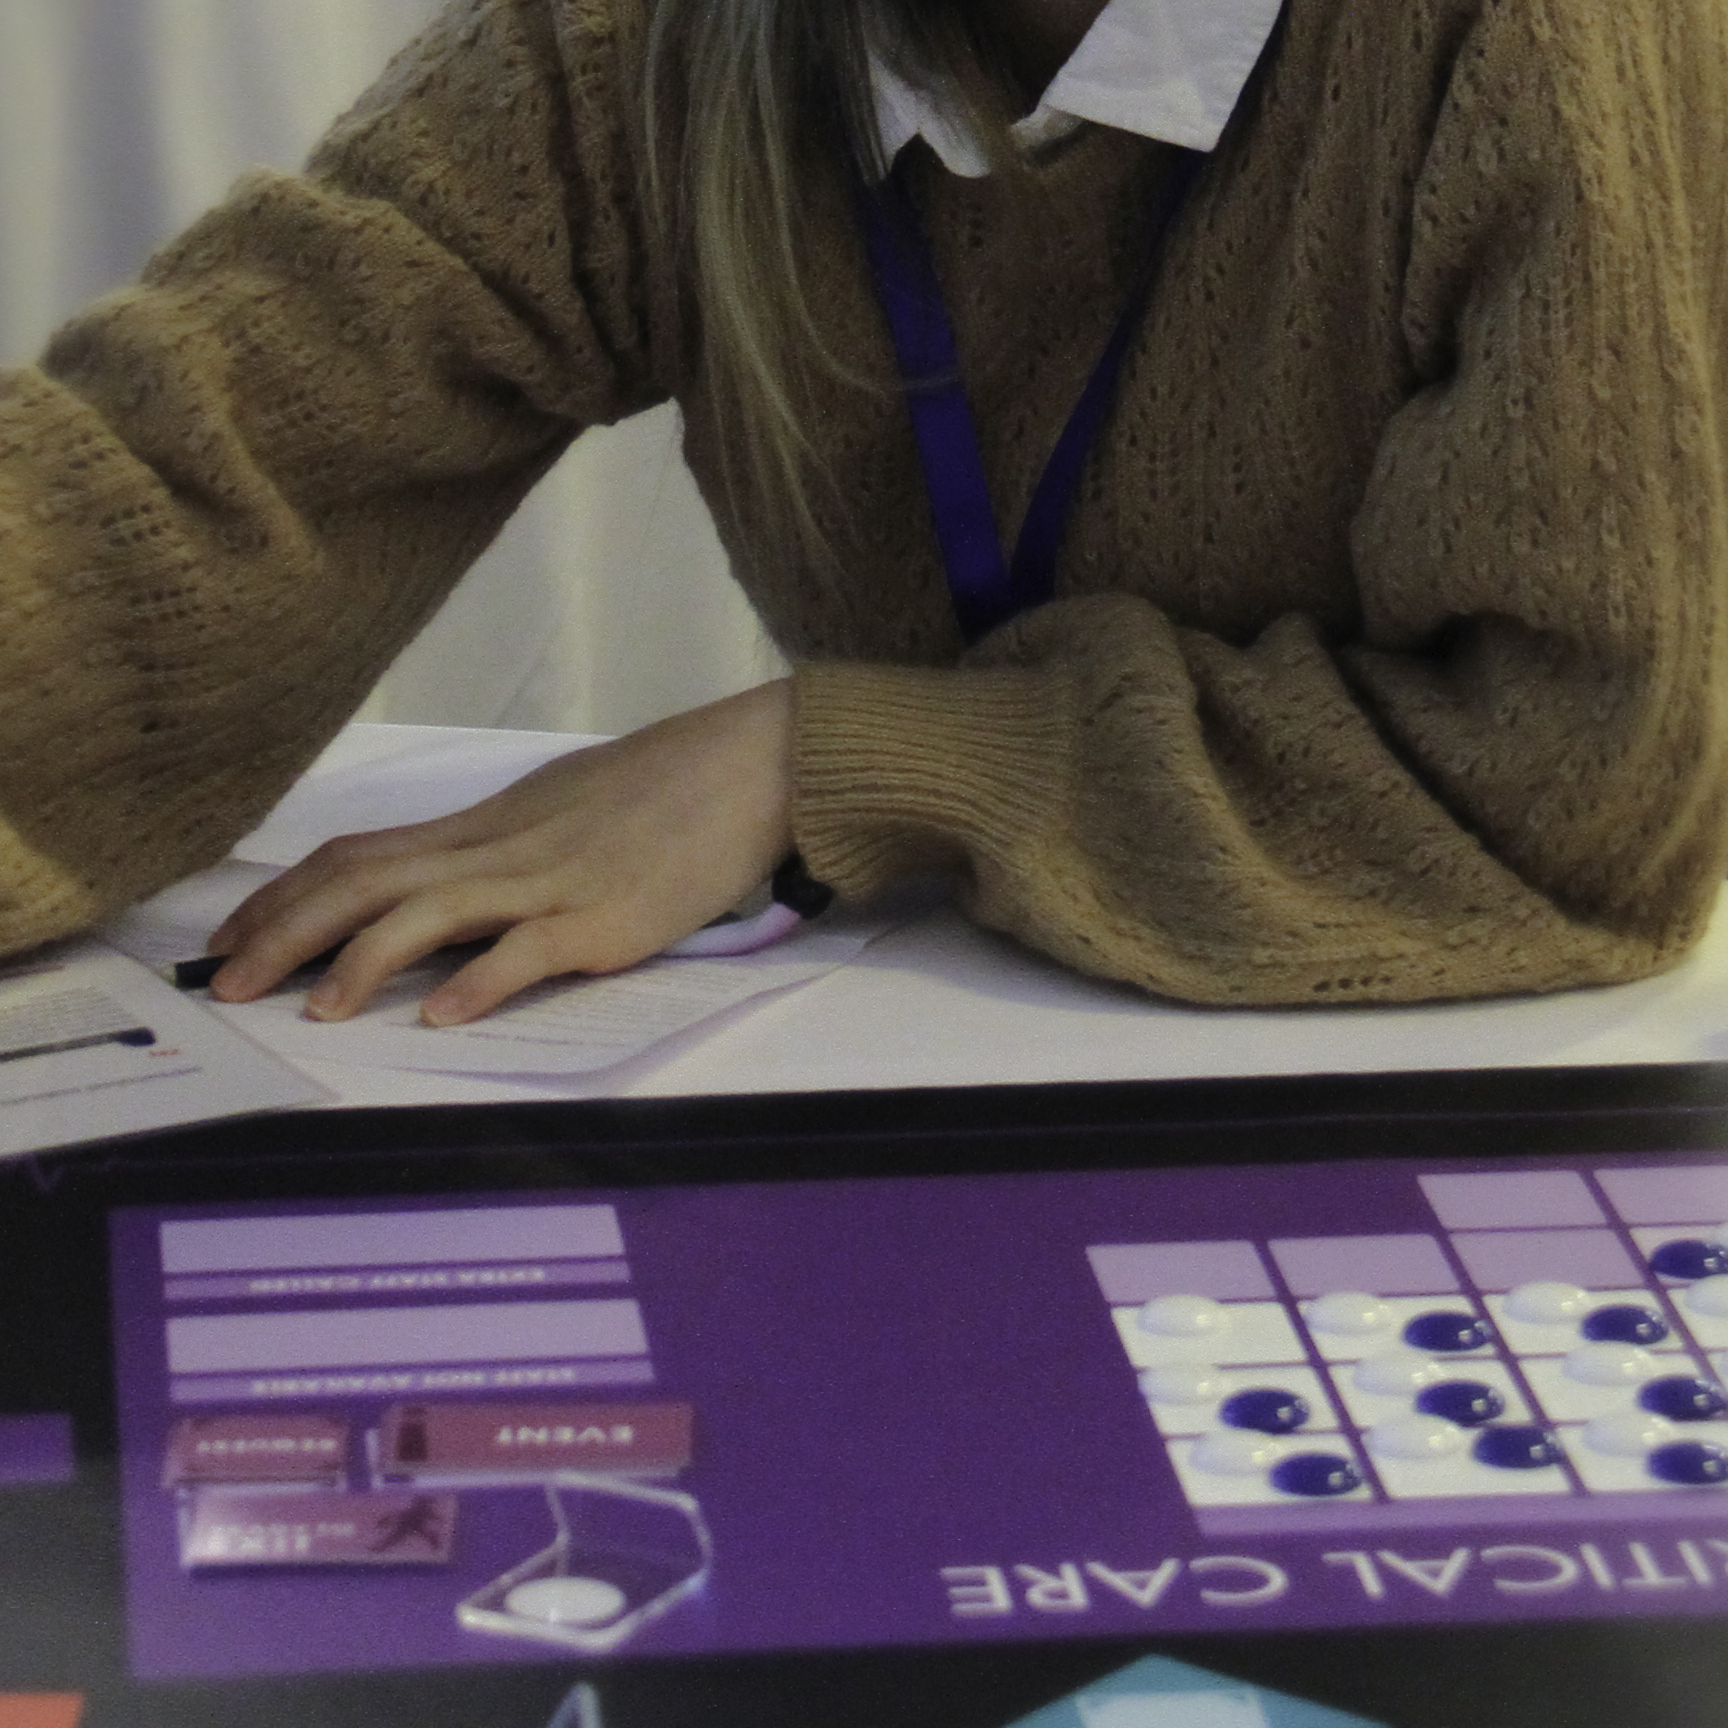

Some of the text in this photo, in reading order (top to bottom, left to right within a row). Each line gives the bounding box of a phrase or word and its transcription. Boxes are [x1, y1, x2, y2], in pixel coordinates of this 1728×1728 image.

[368, 1271, 450, 1290] STAFF
[251, 1368, 576, 1397] STAFF NOT AVAILABLE
[495, 1425, 635, 1444] EVENT
[195, 1437, 338, 1454] REQUEST
[937, 1553, 1290, 1617] CARE
